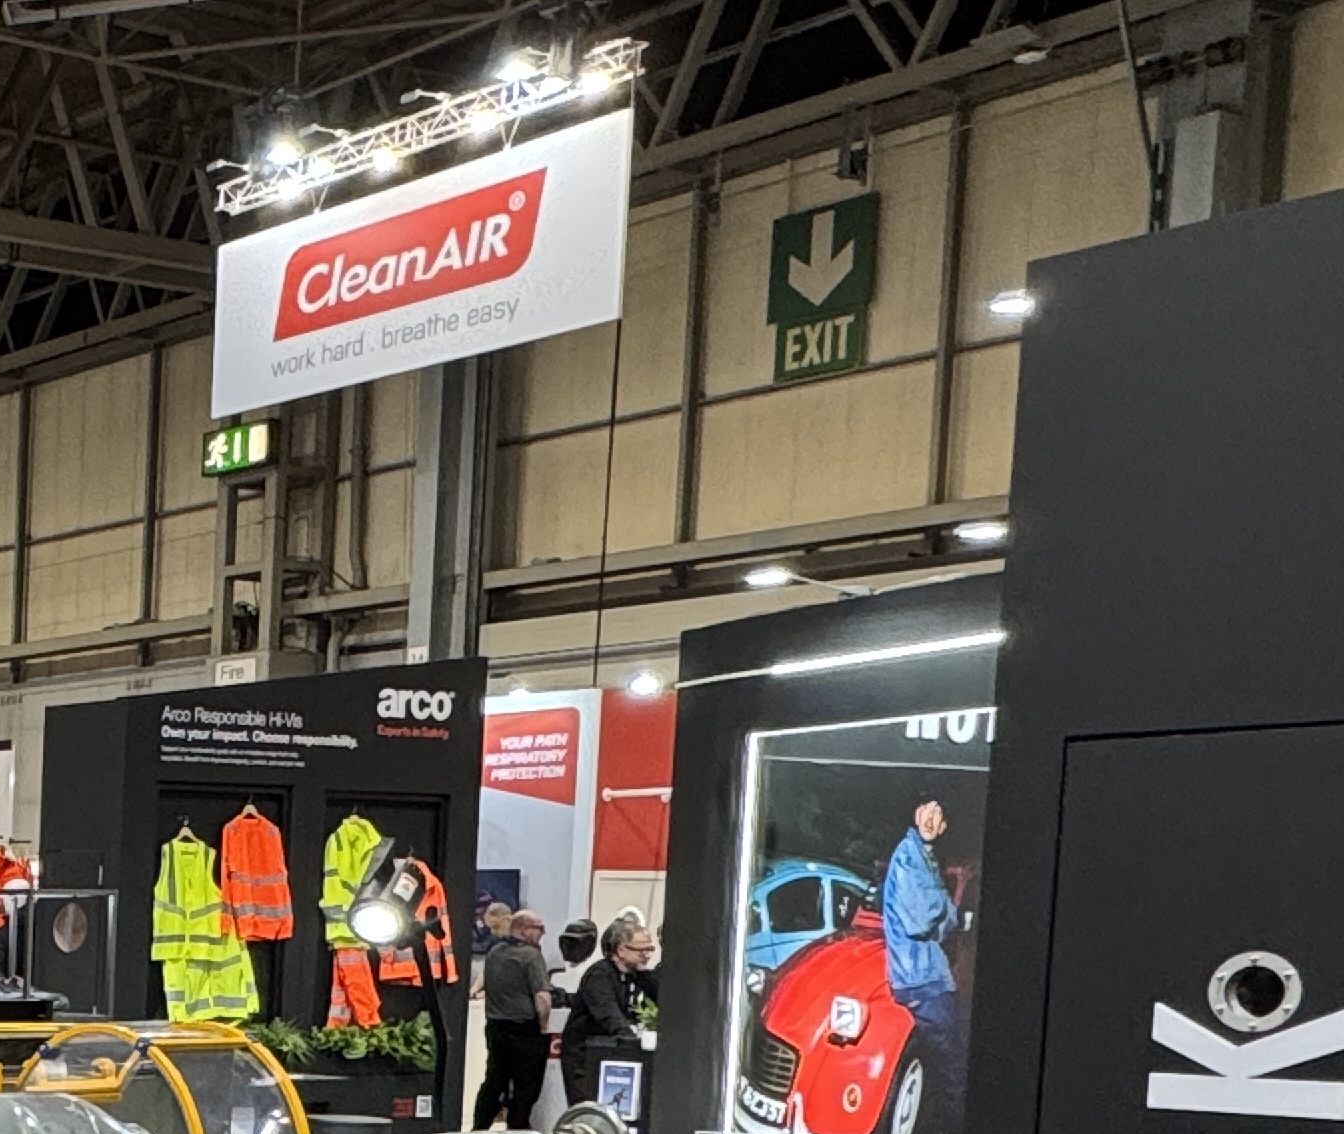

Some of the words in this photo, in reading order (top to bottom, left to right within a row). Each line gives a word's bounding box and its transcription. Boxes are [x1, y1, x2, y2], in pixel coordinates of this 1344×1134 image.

[297, 212, 512, 314] CleanAIR
[271, 347, 316, 378] work
[321, 338, 363, 366] hard
[381, 312, 460, 350] breathe
[466, 297, 520, 326] easy
[785, 313, 856, 371] EXIT
[220, 664, 244, 681] Fire
[162, 705, 191, 723] Arco
[194, 706, 267, 727] Responsible
[377, 688, 453, 722] arco
